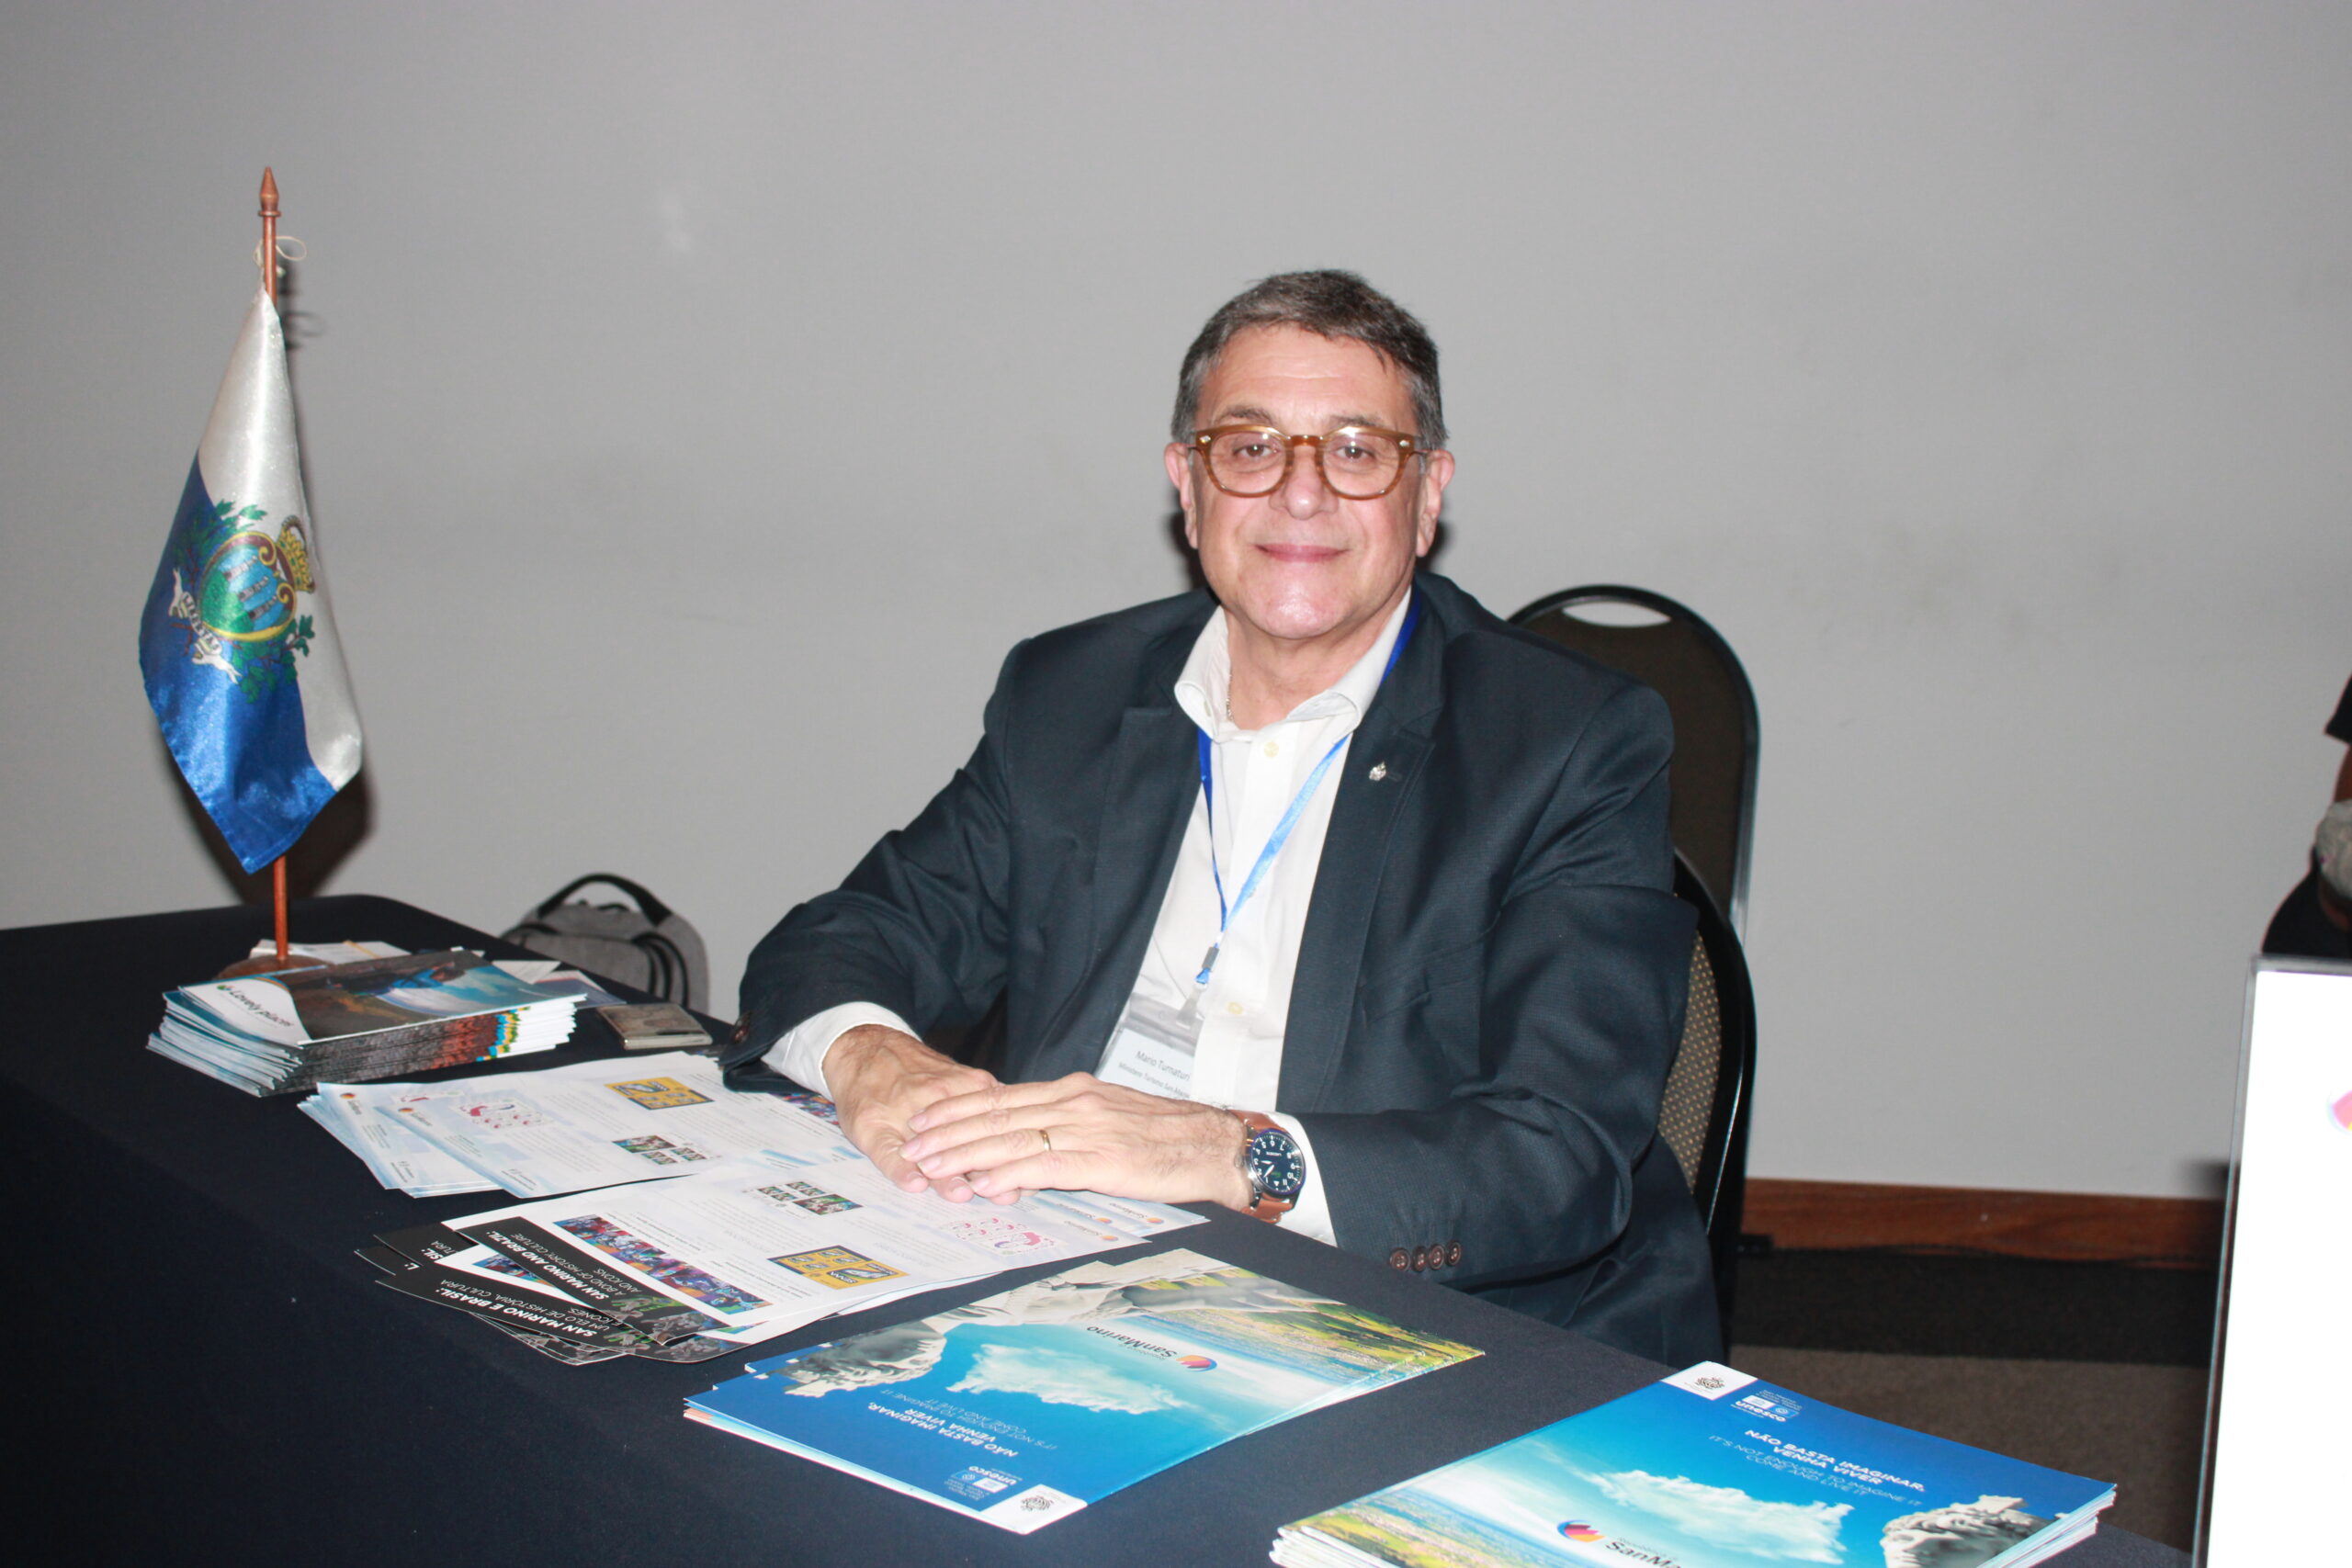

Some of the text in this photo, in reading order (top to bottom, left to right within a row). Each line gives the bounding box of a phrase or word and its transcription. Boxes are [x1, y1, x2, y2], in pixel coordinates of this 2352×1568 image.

[1136, 1051, 1158, 1066] Mario
[511, 1233, 548, 1254] CULTURE
[486, 1231, 610, 1300] SAN MARINO AND BRAZIL:
[577, 1271, 594, 1280] OF
[590, 1278, 618, 1292] BOND
[440, 1279, 492, 1297] CULTURA
[618, 1280, 643, 1293] AND
[435, 1287, 598, 1337] SAN MARINO E BRASIL:
[546, 1310, 566, 1319] DE
[564, 1315, 591, 1325] ELO
[588, 1323, 610, 1331] UM
[1086, 1325, 1177, 1359] SanMarino
[1735, 1400, 1787, 1423] unesco
[904, 1408, 997, 1442] VENHA VIVER
[938, 1427, 985, 1446] BASTA
[983, 1442, 1019, 1458] NÃO
[1745, 1429, 1782, 1446] NÃO
[1783, 1443, 1836, 1464] BASTA
[1773, 1446, 1883, 1485] VENHA VIVER
[968, 1465, 1018, 1486] unesco
